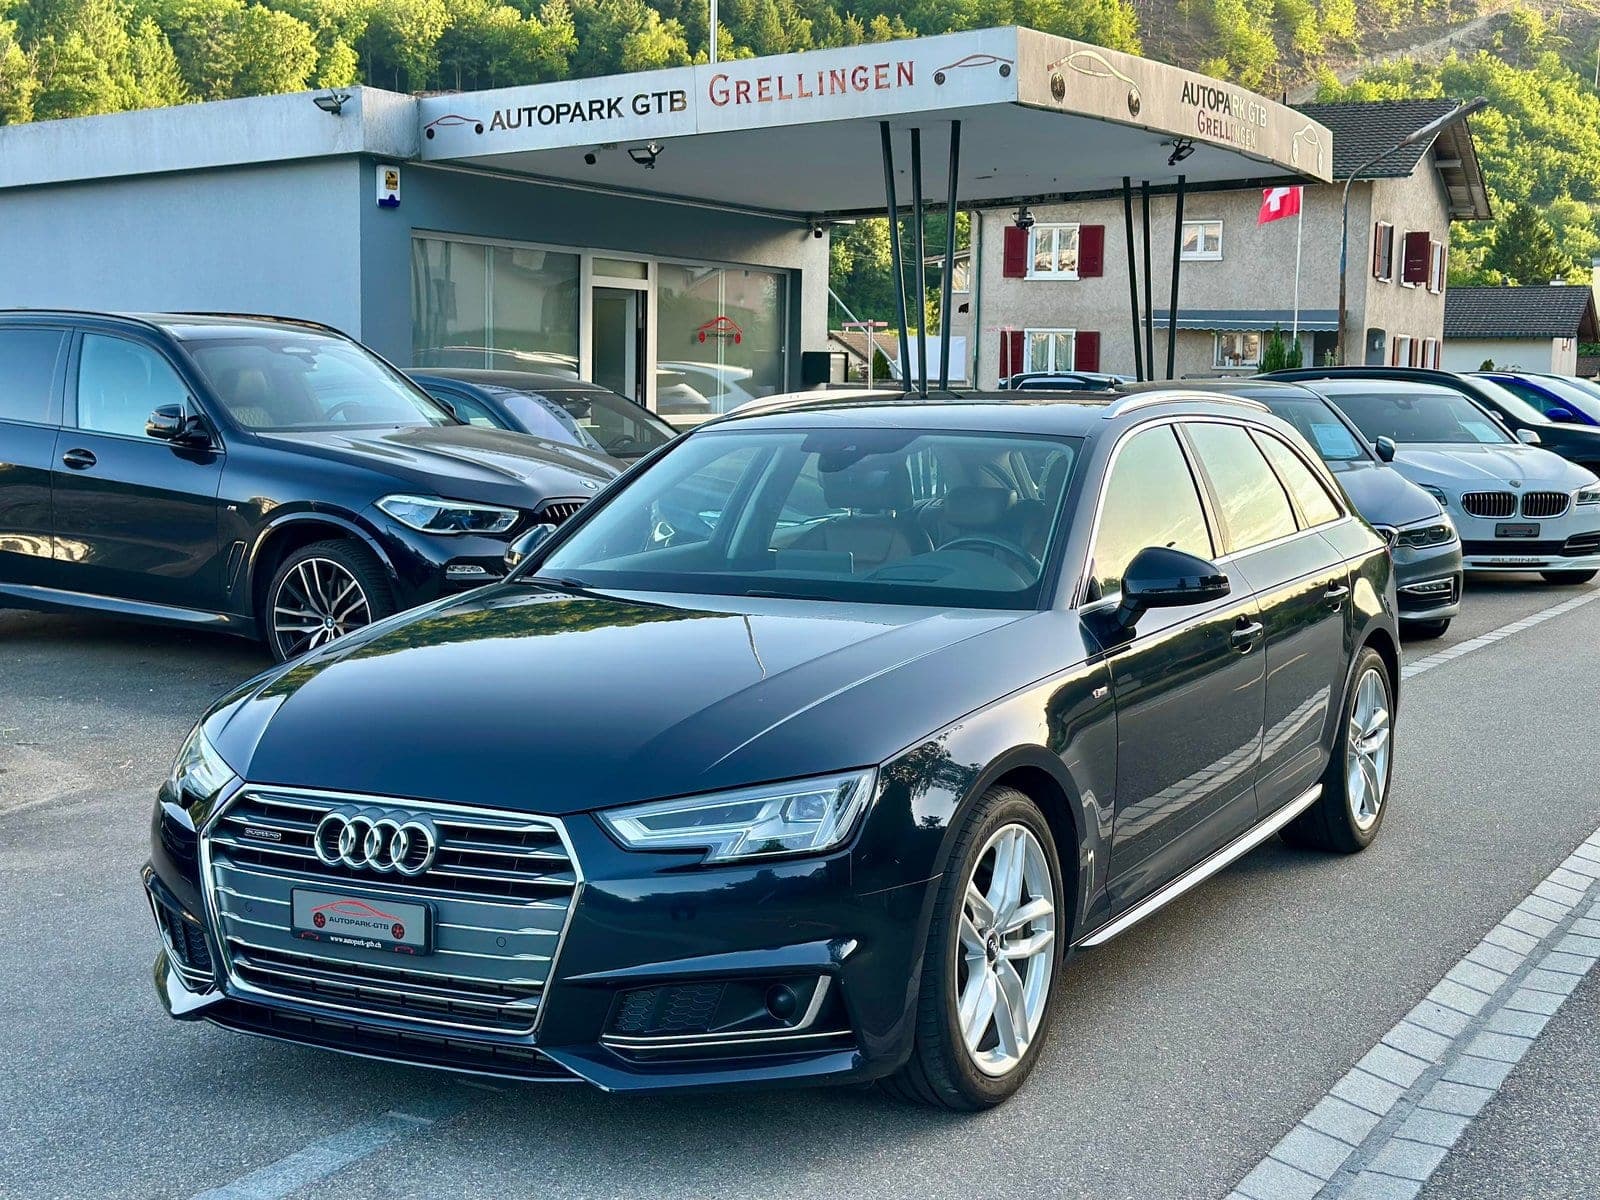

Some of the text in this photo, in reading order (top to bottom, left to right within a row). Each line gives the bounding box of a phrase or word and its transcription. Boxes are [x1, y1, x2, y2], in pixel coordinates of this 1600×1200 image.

[490, 61, 915, 131] AUTOPARK GTB GRELLINGEN
[1181, 80, 1268, 128] AUTOPARK GTB
[1197, 110, 1256, 149] GRELLINGEN
[329, 916, 390, 930] AUTOPARK-GTB
[330, 935, 382, 949] www.autopark-gtb.ch
